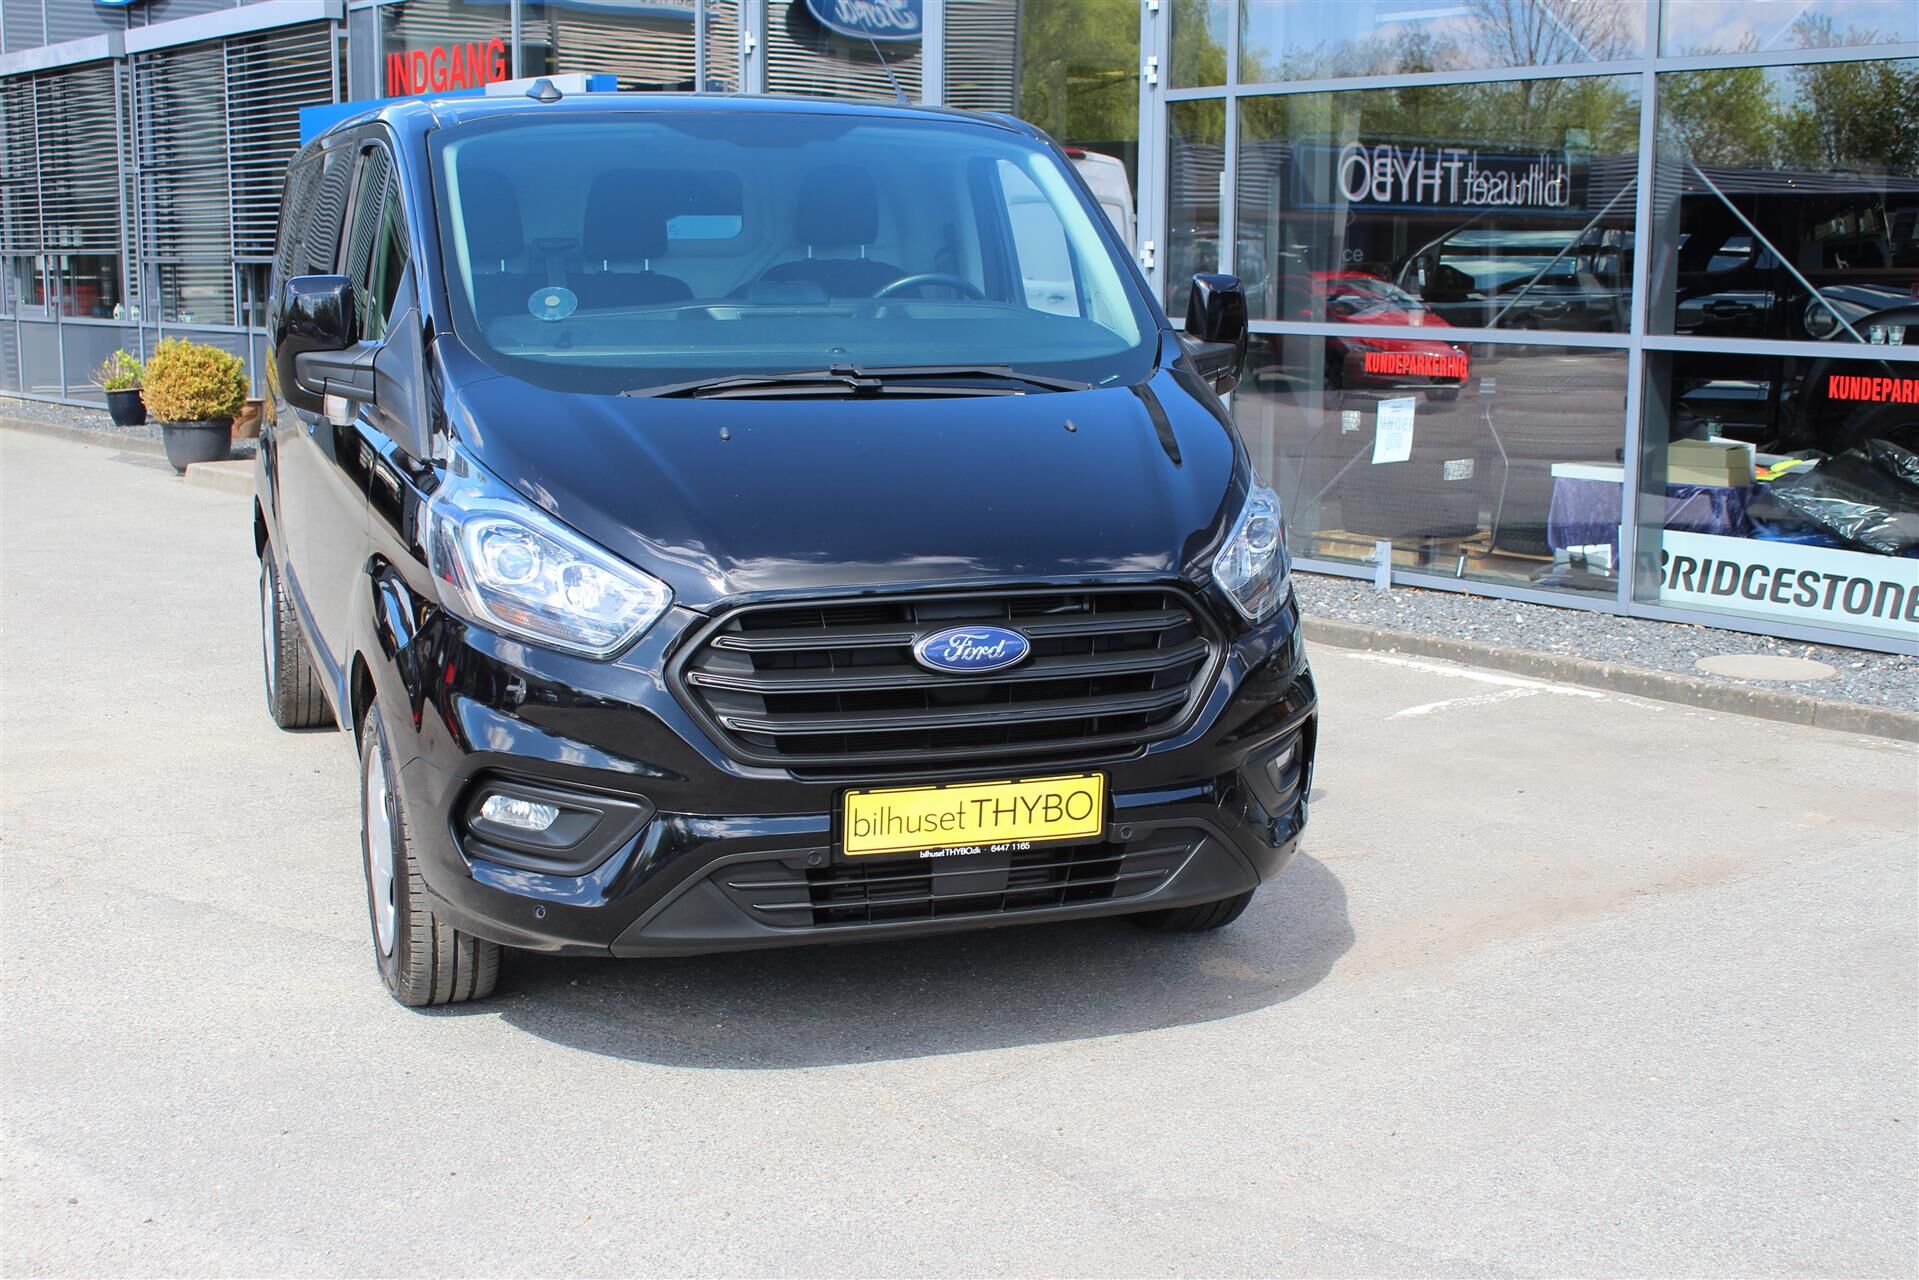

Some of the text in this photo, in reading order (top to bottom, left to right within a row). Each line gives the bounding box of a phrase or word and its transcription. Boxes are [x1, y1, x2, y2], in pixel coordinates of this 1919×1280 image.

[387, 37, 506, 96] INDGANG
[1364, 351, 1469, 381] KUNDEPARKERING
[944, 634, 1006, 661] Ford
[990, 843, 1010, 853] 6447
[1012, 842, 1031, 850] 1165
